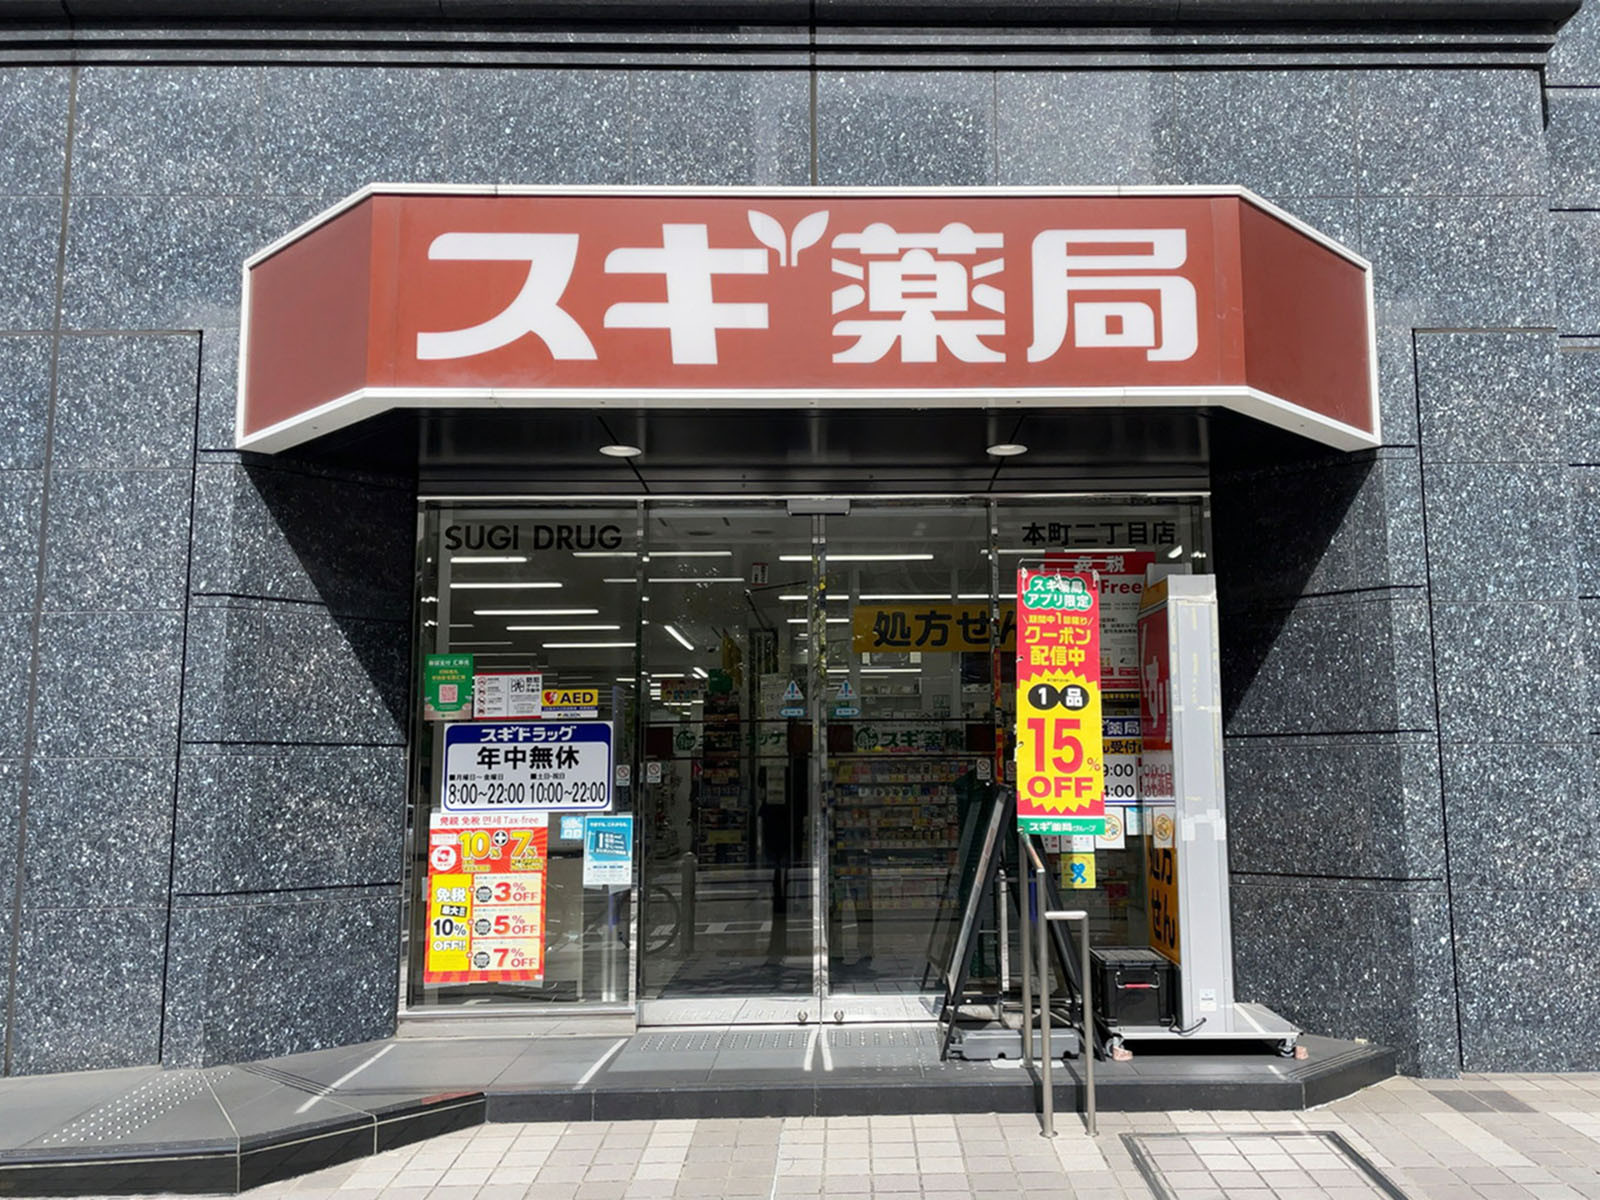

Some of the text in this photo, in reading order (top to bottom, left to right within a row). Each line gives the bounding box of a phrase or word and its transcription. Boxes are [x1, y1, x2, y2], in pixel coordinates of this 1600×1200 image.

[416, 209, 1198, 365] スギ薬局
[445, 525, 622, 550] SUGI DRUG
[1022, 522, 1176, 546] 本町二丁目店
[1027, 593, 1090, 608] アプリ限定
[1025, 626, 1091, 645] クーポン
[1030, 645, 1086, 667] 配信中
[560, 692, 594, 704] AED
[480, 725, 577, 742] スギドラッグ
[477, 745, 580, 770] 年中無休
[1027, 776, 1093, 798] OFF
[513, 892, 538, 901] OFF
[433, 918, 467, 936] 10%
[512, 925, 537, 934] OFF
[511, 958, 537, 967] OFF
